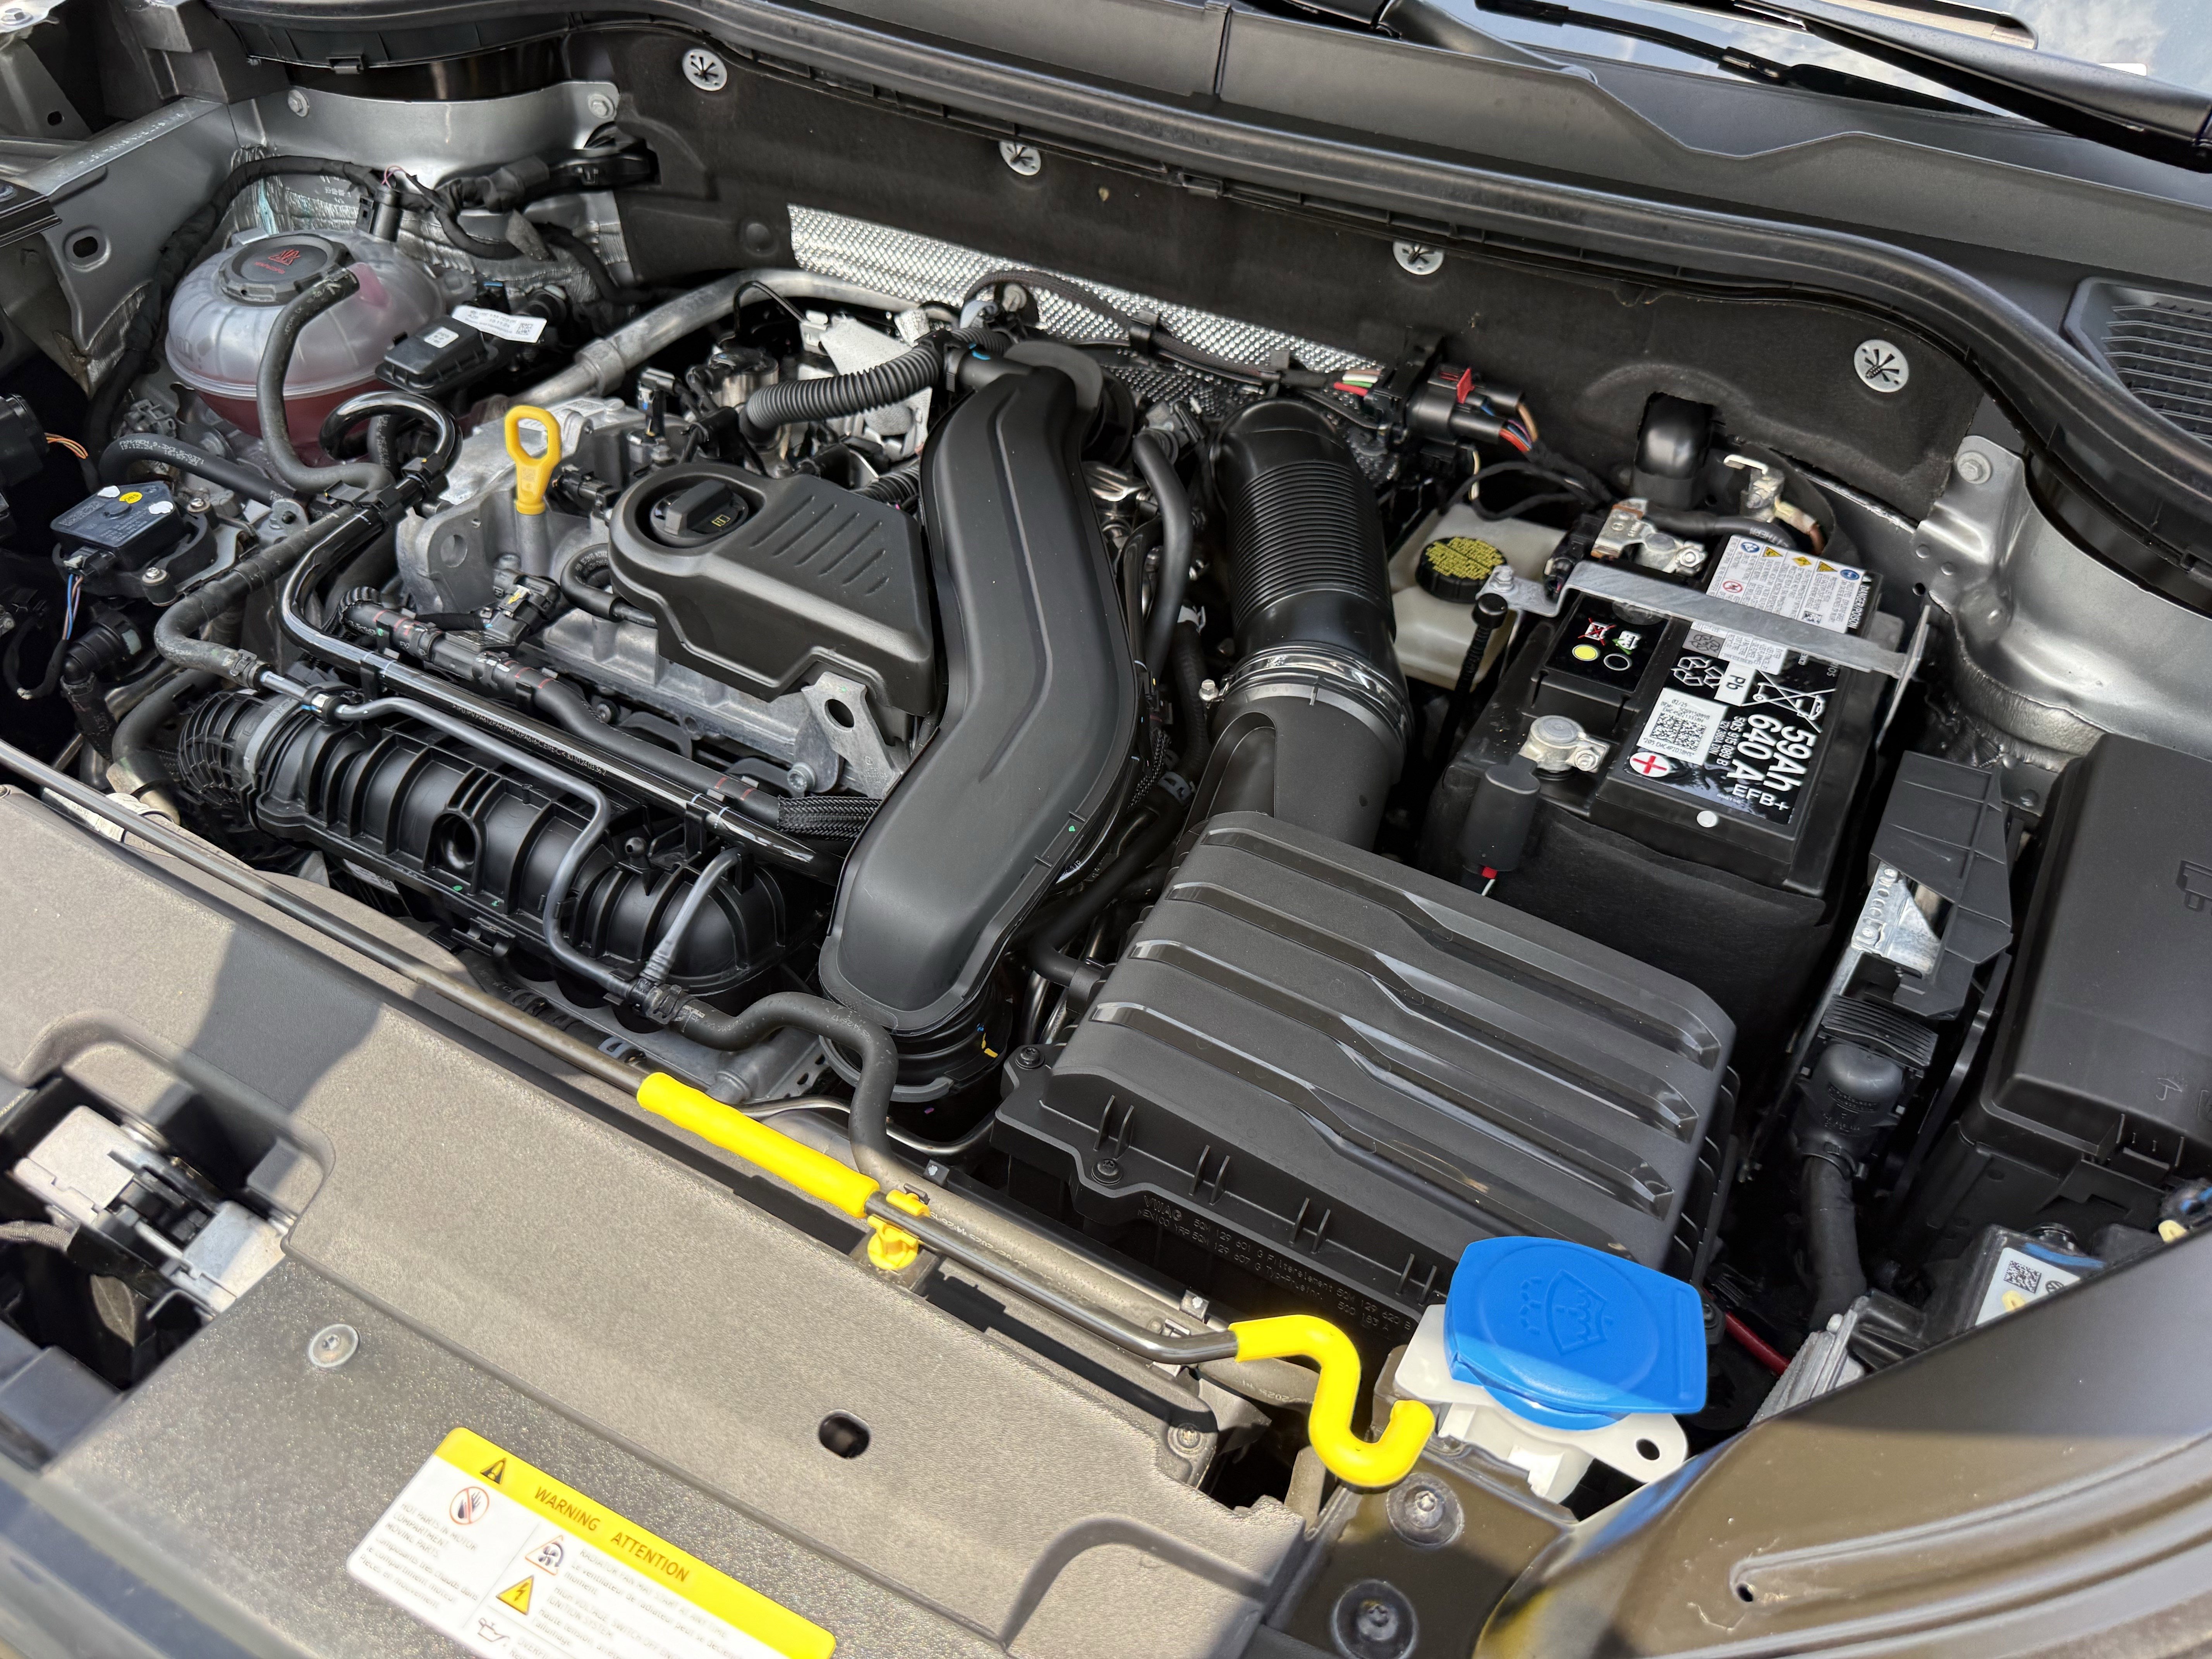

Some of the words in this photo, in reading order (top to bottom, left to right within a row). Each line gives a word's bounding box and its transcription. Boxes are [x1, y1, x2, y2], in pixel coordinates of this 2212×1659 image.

[1847, 584, 1869, 630] DANGER/POISON
[1724, 674, 1746, 692] Pb
[1712, 728, 1726, 745] 380A
[1718, 720, 1730, 730] 12V
[1724, 731, 1740, 745] 915
[1735, 711, 1783, 763] 640
[1708, 742, 1719, 756] DIN
[1716, 757, 1728, 766] B
[1719, 743, 1734, 760] 089
[1762, 725, 1818, 792] 59Ah
[1726, 758, 1767, 786] A
[1732, 783, 1791, 812] EFB+
[1140, 1193, 1184, 1223] VWAG
[1214, 1228, 1232, 1243] 129
[1255, 1249, 1264, 1258] G
[1358, 1299, 1378, 1314] 129
[1212, 1242, 1231, 1256] 129
[1233, 1251, 1251, 1266] 607
[1252, 1261, 1262, 1272] G
[384, 1520, 417, 1544] MOVING
[400, 1502, 417, 1516] HOT
[416, 1511, 441, 1530] PARTS
[440, 1525, 450, 1535] IN
[448, 1530, 479, 1552] MOTOR
[532, 1485, 602, 1533] WARNING
[609, 1529, 691, 1584] ATTENTION
[373, 1549, 429, 1587] compartiment
[374, 1534, 420, 1565] Composants
[433, 1569, 462, 1590] chauds
[460, 1585, 480, 1601] dans
[578, 1548, 620, 1577] RADIATOR
[580, 1566, 626, 1597] ventilateur
[624, 1591, 637, 1604] de
[546, 1595, 583, 1621] IGNITION
[609, 1618, 644, 1642] SWITCH
